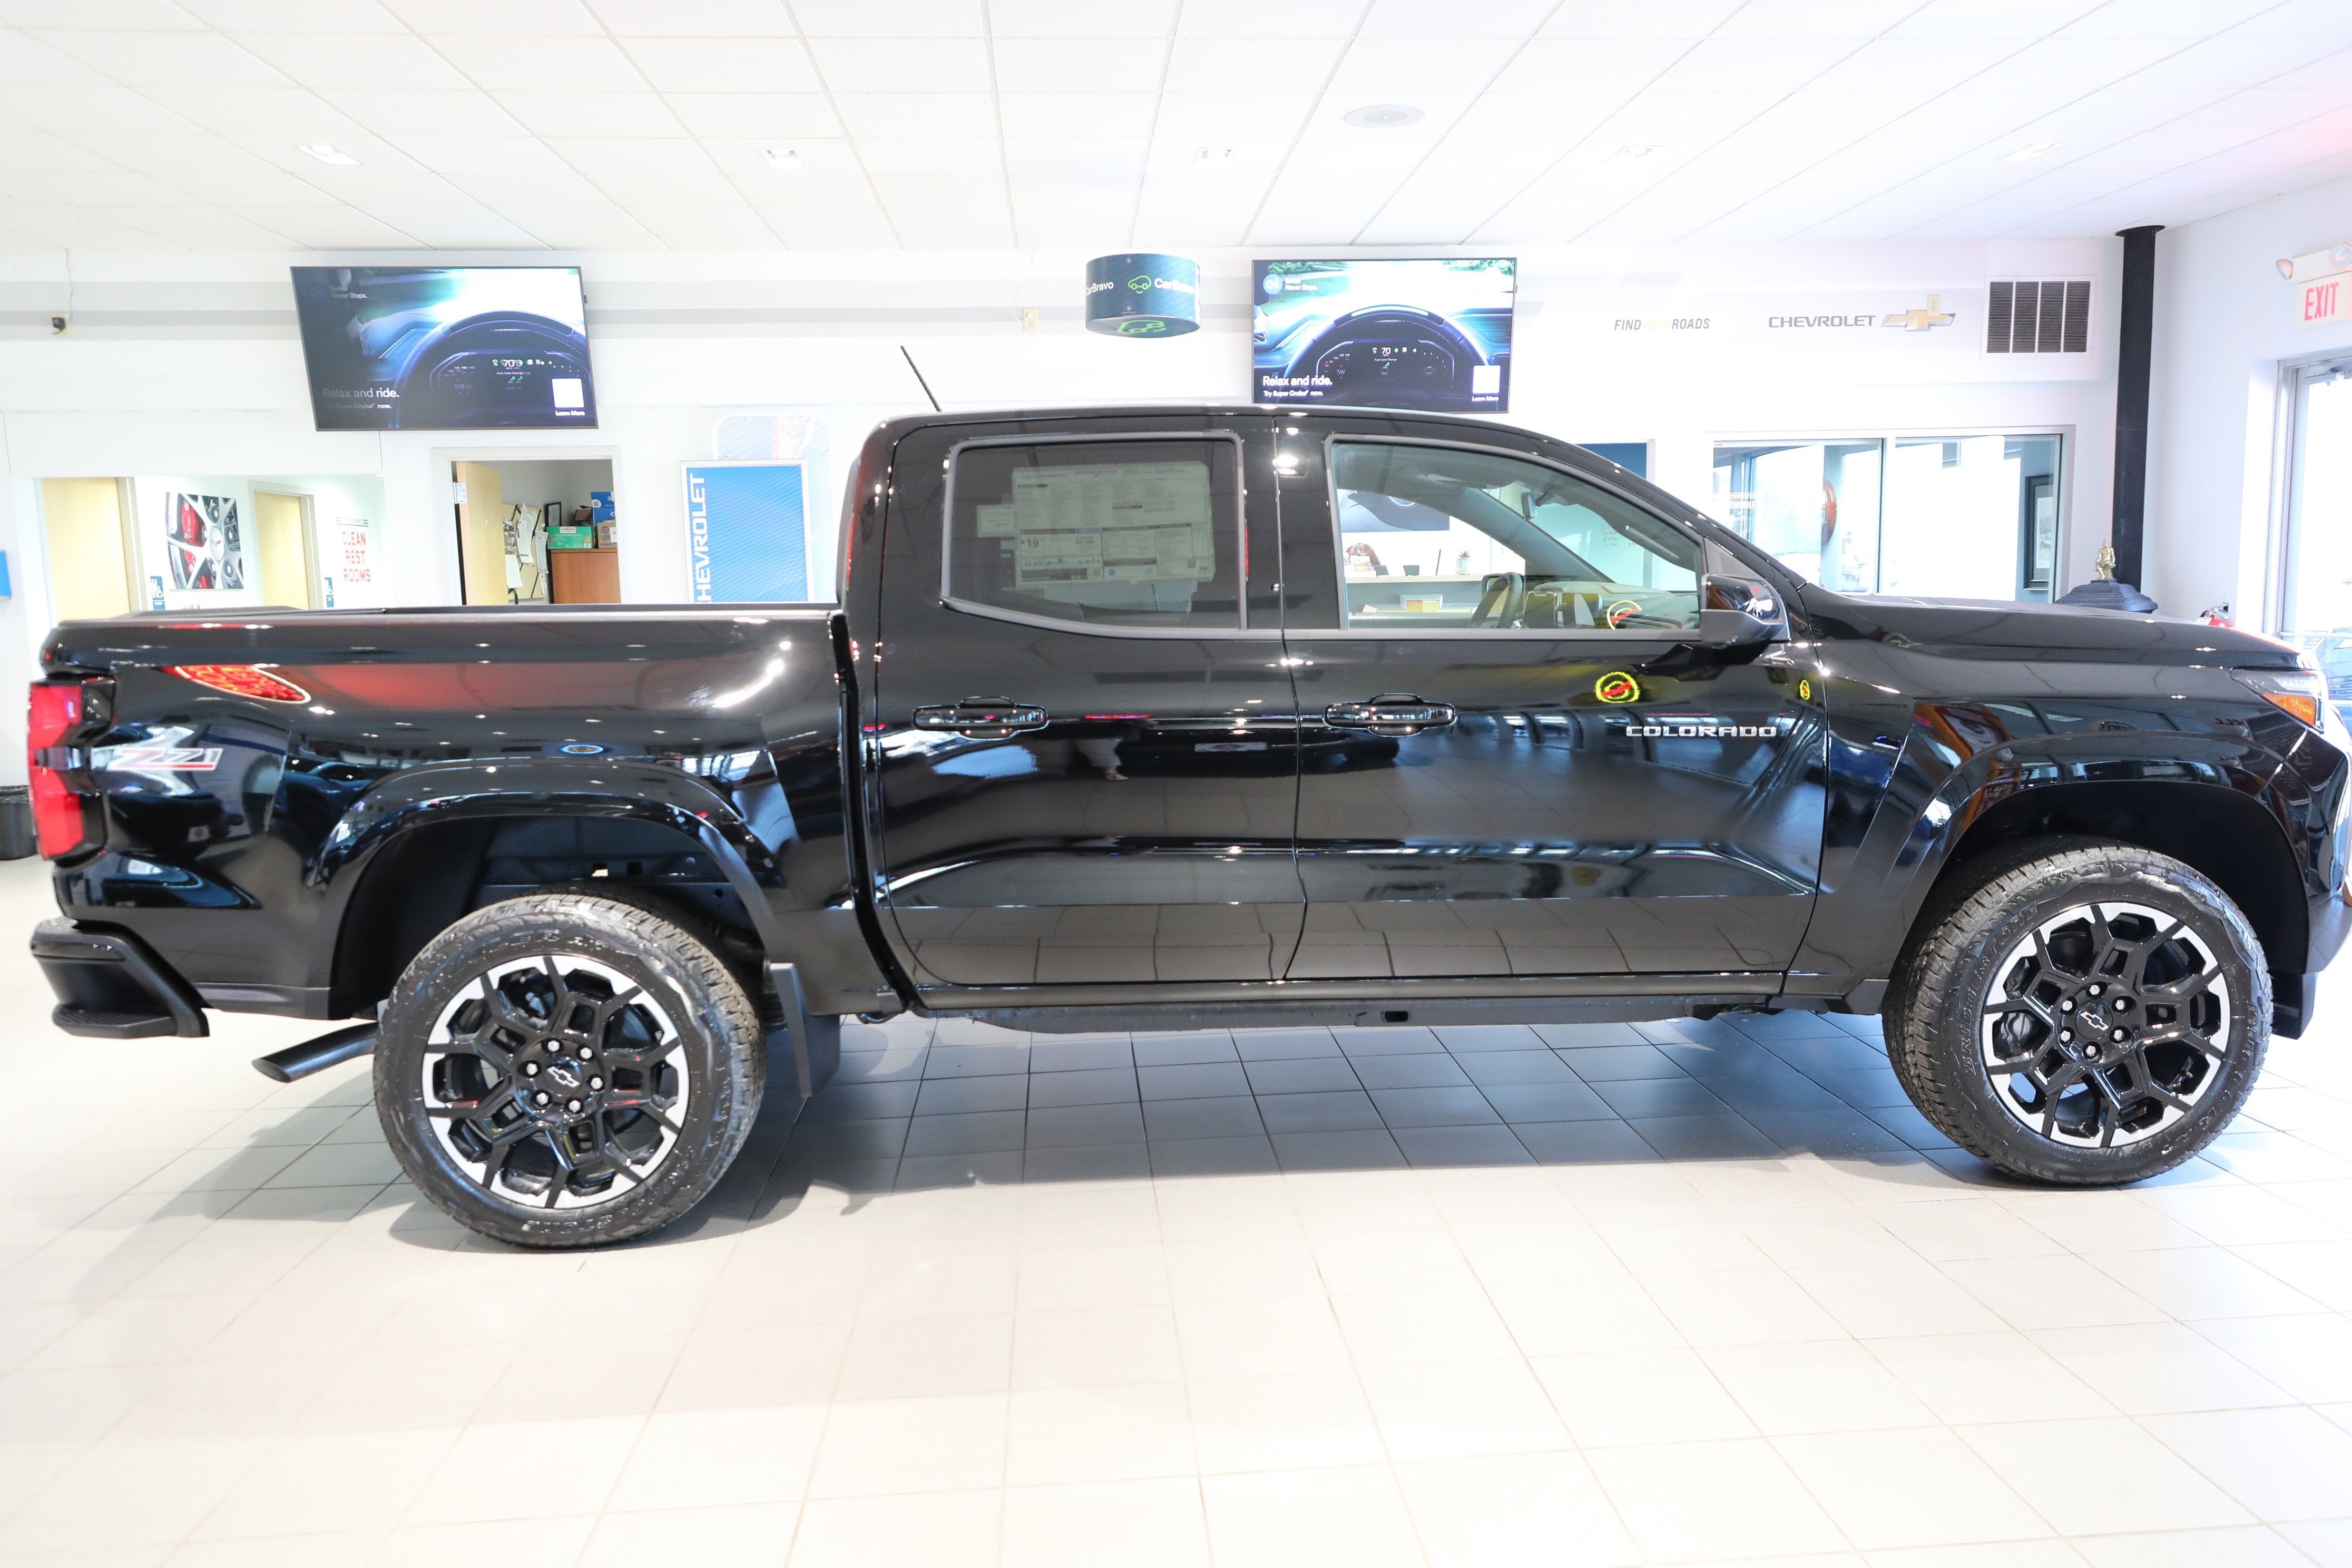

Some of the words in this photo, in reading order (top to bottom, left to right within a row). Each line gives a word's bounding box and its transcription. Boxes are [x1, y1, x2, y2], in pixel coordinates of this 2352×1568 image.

[1086, 281, 1114, 296] CarBravo
[2304, 282, 2339, 321] EXIT
[1614, 319, 1641, 330] FIND
[1672, 318, 1710, 330] ROADS
[1769, 315, 1876, 328] CHEVROLET
[1263, 375, 1289, 386] Relax
[1291, 375, 1309, 386] and
[1311, 375, 1332, 386] ride.
[322, 388, 351, 398] Relax
[354, 387, 374, 398] and
[376, 387, 400, 398] ride.
[342, 532, 366, 546] CLEAN
[688, 473, 712, 603] HEVROLET
[1027, 539, 1038, 547] 19
[345, 550, 365, 564] REST
[343, 568, 371, 582] ROOMS
[1625, 726, 1777, 738] COLORADO
[109, 747, 224, 771] Z71
